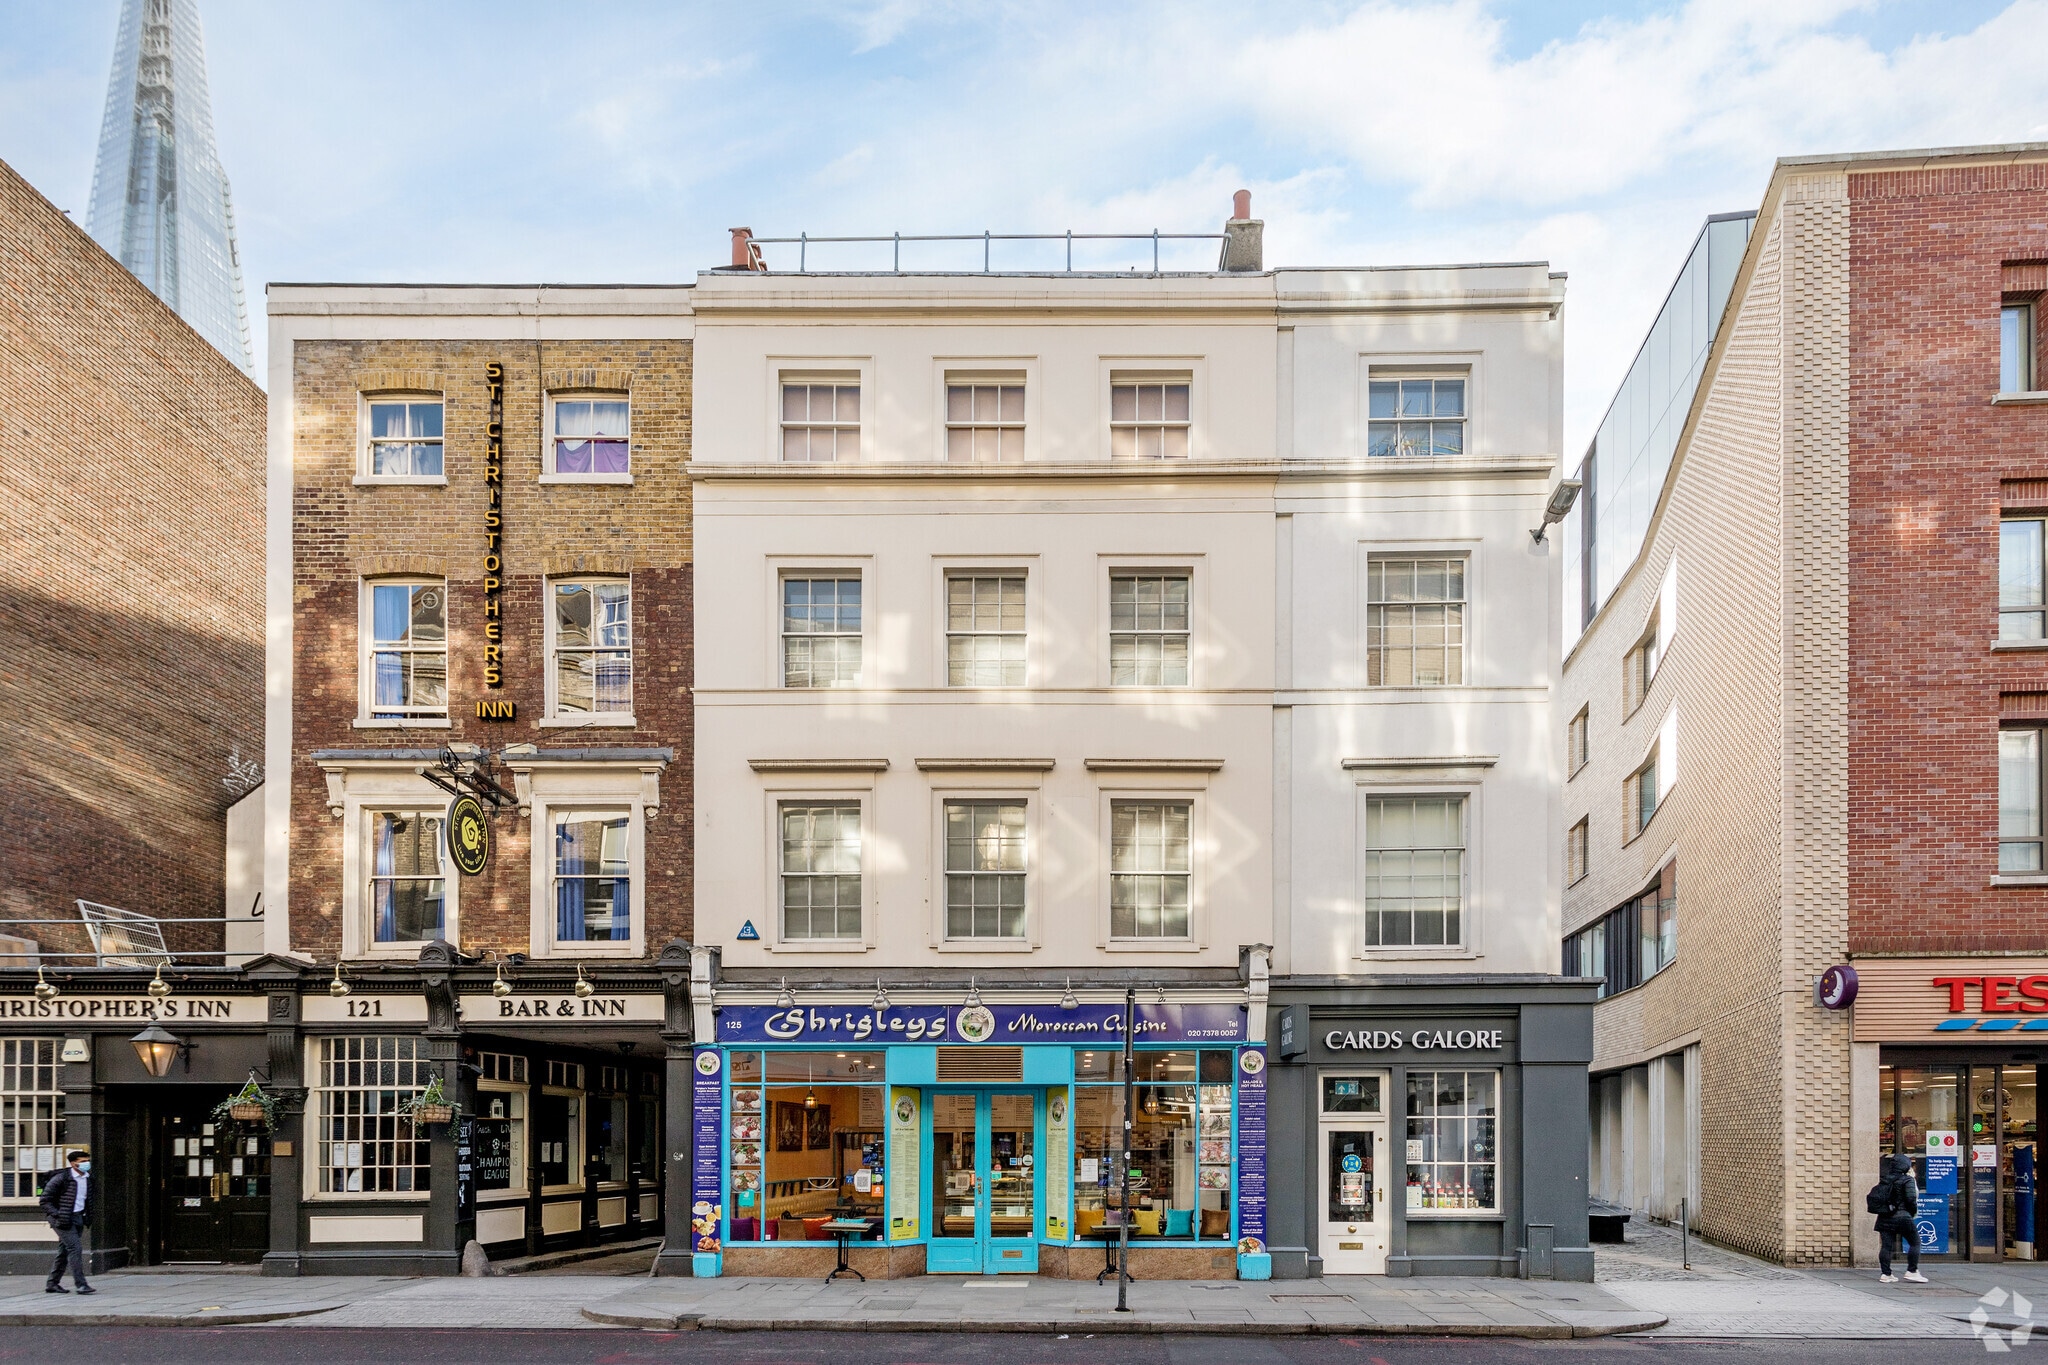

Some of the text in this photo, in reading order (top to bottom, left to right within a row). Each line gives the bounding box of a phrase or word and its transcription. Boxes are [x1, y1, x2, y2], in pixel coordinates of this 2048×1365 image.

[485, 361, 504, 686] ST CHRISTOPHERS
[477, 701, 514, 722] INN
[1933, 975, 2048, 1012] TES
[187, 999, 232, 1018] INN
[346, 999, 382, 1018] 121
[498, 999, 627, 1018] BAR & INN
[726, 1021, 742, 1030] 125
[764, 1008, 947, 1040] Shrigleys
[1008, 1013, 1099, 1034] Moroccan
[1102, 1013, 1168, 1034] Cusine
[1187, 1029, 1238, 1037] 020 7378 0057
[1324, 1030, 1502, 1049] CARDS GALORE
[476, 1156, 518, 1169] HAMPIONS
[483, 1169, 510, 1180] LEAGUE
